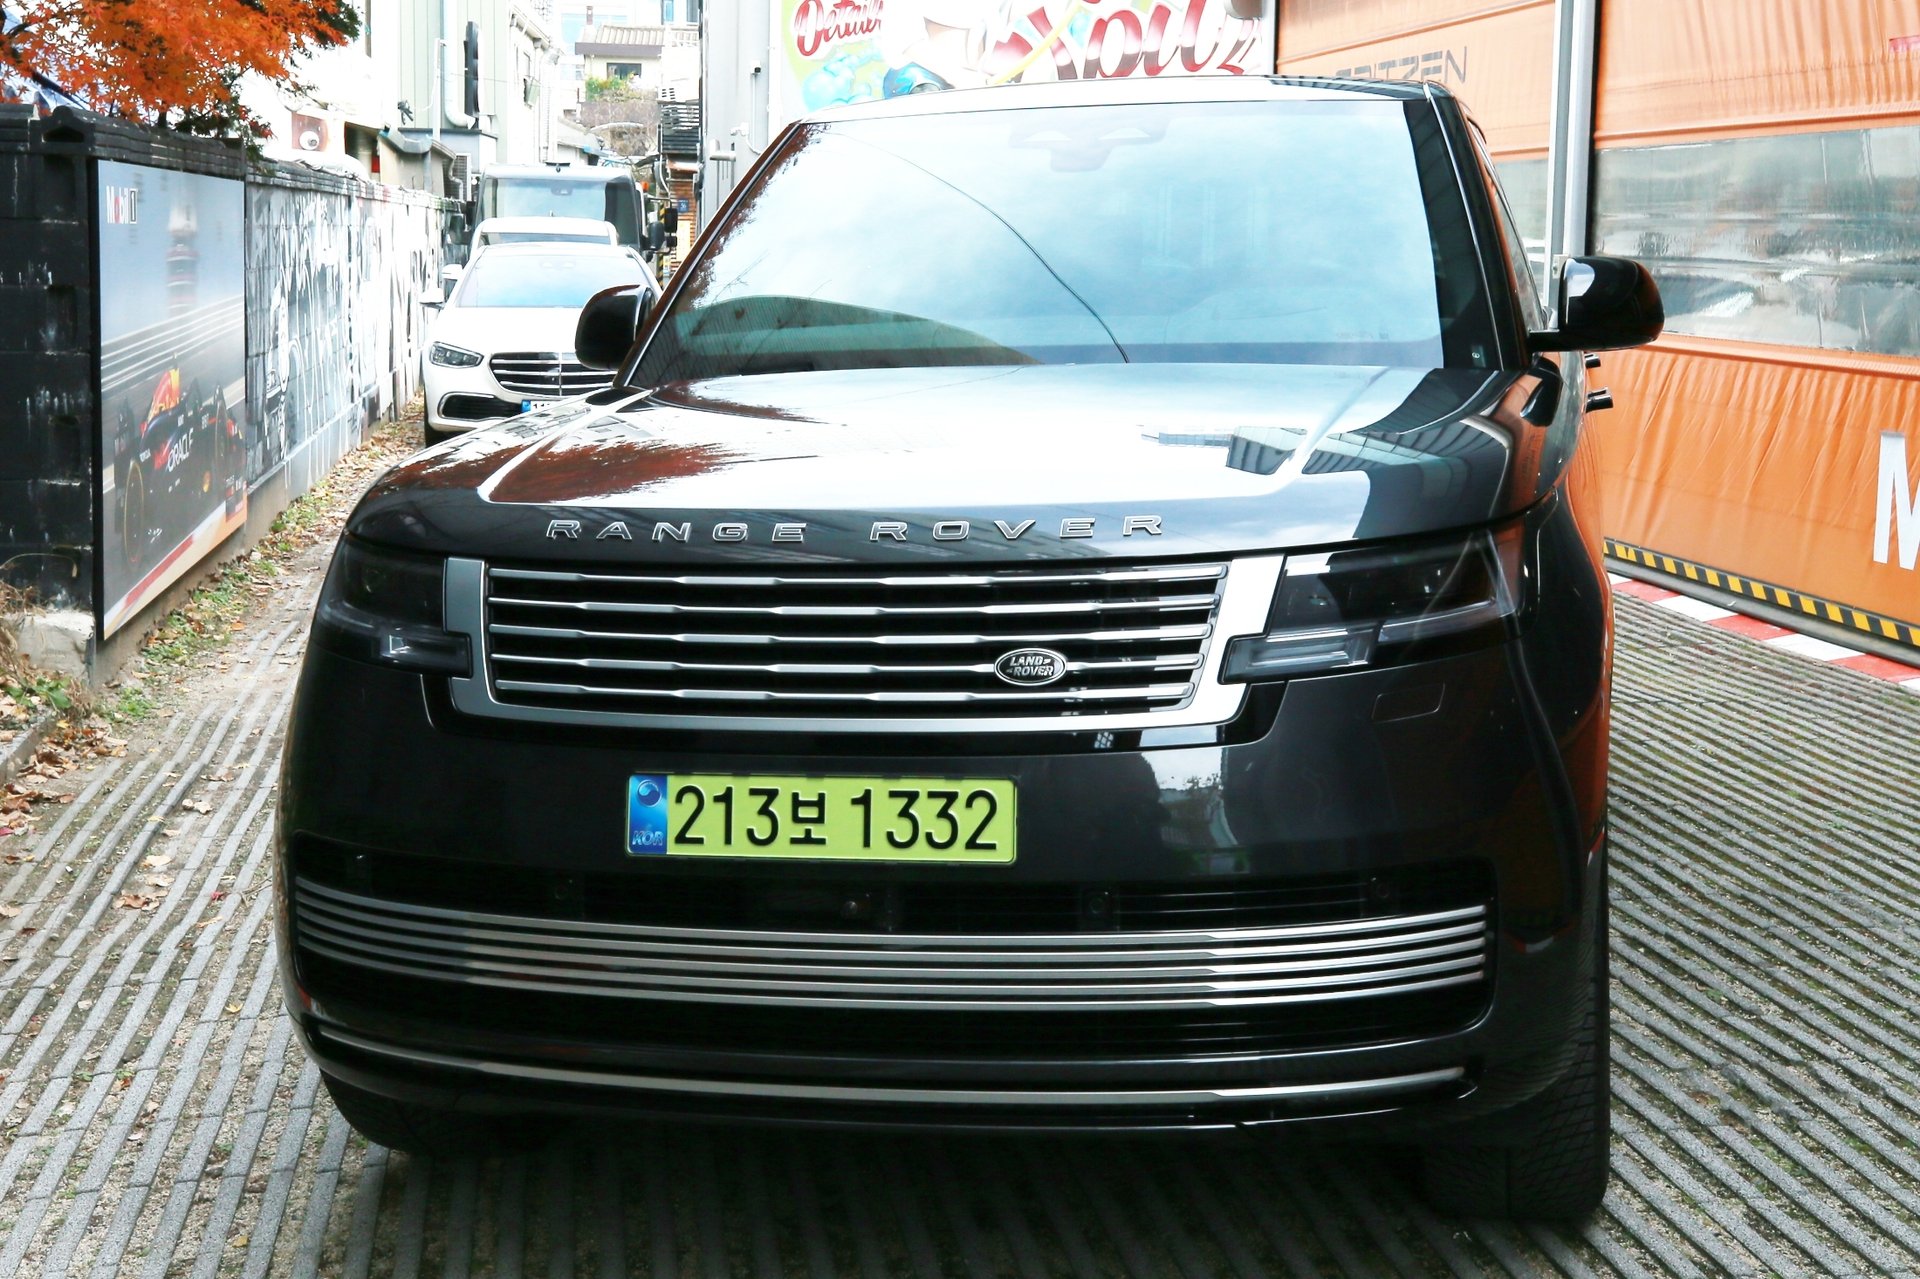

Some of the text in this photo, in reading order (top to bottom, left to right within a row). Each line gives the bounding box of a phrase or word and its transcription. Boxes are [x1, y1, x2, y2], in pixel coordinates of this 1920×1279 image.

[106, 185, 129, 224] Mobil
[546, 515, 1163, 542] RANGE ROVER
[1010, 655, 1044, 667] LAND
[1013, 665, 1054, 676] ROVER
[674, 785, 998, 850] 213보 1332
[632, 830, 664, 846] KOR
